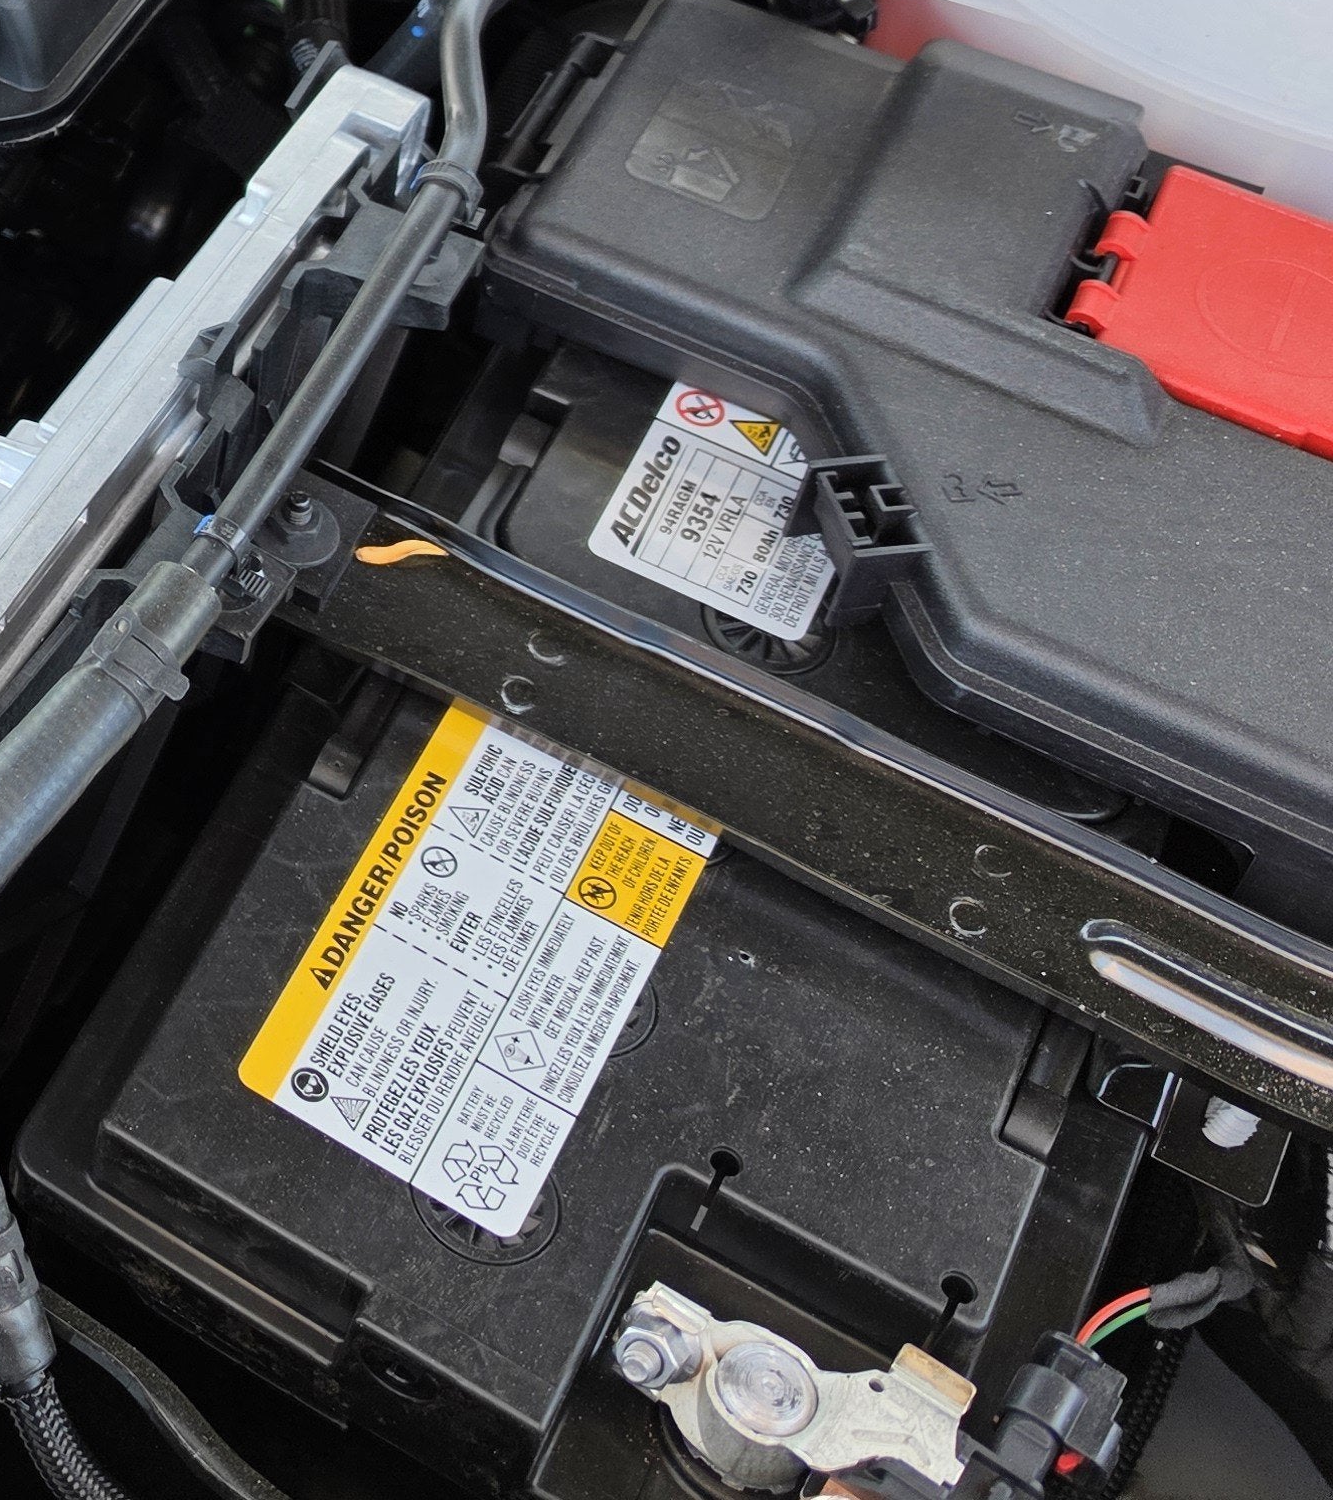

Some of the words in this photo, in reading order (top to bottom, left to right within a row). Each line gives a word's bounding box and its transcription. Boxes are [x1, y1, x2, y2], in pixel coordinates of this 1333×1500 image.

[610, 436, 681, 546] ACDelco
[658, 478, 697, 536] 94RAGM
[773, 494, 794, 522] 730
[678, 489, 721, 545] 9354
[701, 534, 726, 562] 12V
[714, 491, 748, 535] VRLA
[752, 527, 779, 564] 80Ah
[735, 568, 758, 597] 730
[753, 570, 784, 616] GENERAL
[768, 601, 787, 622] 300
[778, 538, 817, 605] RENAISSANCE
[782, 583, 814, 630] DETROIT,
[802, 571, 818, 587] MI
[462, 742, 504, 796] SULFURIC
[479, 775, 506, 805] ACID
[495, 755, 517, 779] CAN
[524, 764, 555, 802] BURNS.
[570, 770, 597, 796] CÉC
[478, 812, 507, 847] CAUSE
[496, 758, 537, 814] BLINDNESS
[503, 800, 535, 840] SEVERE
[512, 824, 545, 866] L'ACIDE
[531, 763, 579, 828] SULFURIQUE
[564, 791, 607, 847] BRÛLURES
[567, 792, 585, 809] LA
[495, 836, 515, 856] OR
[545, 807, 578, 849] CAUSER
[598, 832, 617, 851] OUT
[607, 821, 623, 835] OF
[318, 770, 448, 968] DANGER/POISON
[531, 846, 557, 875] PEUT
[556, 844, 579, 868] DES
[588, 848, 608, 871] KEEP
[605, 860, 624, 880] THE
[613, 835, 637, 865] REACH
[627, 834, 659, 878] CHILDREN.
[654, 855, 671, 870] LA
[548, 865, 568, 884] OU
[621, 875, 638, 889] OF
[636, 879, 659, 906] HORS
[648, 867, 665, 882] DE
[388, 900, 409, 919] NO
[407, 881, 438, 921] SPARKS
[420, 888, 452, 928] FLAMES
[434, 890, 470, 936] SMOKING
[479, 875, 524, 936] ÉTINCELLES
[624, 902, 648, 929] TENIR
[637, 902, 667, 938] PORTÉE
[656, 891, 673, 907] DE
[444, 907, 483, 953] ÉVITER
[471, 933, 493, 956] LES
[486, 941, 508, 964] LES
[497, 894, 534, 944] FLAMMES
[509, 919, 539, 957] FUMER
[584, 933, 607, 961] FAST.
[501, 953, 520, 972] DE
[508, 988, 535, 1021] FLUSH
[524, 967, 546, 992] EYES
[535, 911, 576, 970] IMMEDIATELY
[572, 957, 595, 983] HELP
[584, 931, 632, 999] IMMÉDIATEMENT.
[403, 974, 438, 1020] INJURY.
[525, 1002, 549, 1030] WITH
[538, 970, 566, 1006] WATER.
[552, 980, 583, 1022] MEDICAL
[604, 956, 642, 1011] RAPIDEMENT.
[325, 1010, 374, 1078] EXPLOSIVE
[362, 971, 396, 1013] GASES
[395, 1017, 414, 1037] OR
[457, 997, 497, 1053] AVEUGLE.
[576, 994, 600, 1021] L'EAU
[583, 1005, 616, 1046] MÉDECIN
[309, 1023, 344, 1068] SHIELD
[333, 988, 364, 1026] EYES.
[543, 1019, 563, 1040] GET
[562, 1024, 584, 1049] YEUX
[344, 1061, 368, 1088] CAN
[357, 1025, 388, 1064] CAUSE
[361, 1035, 405, 1098] BLINDNESS
[554, 1045, 574, 1065] LES
[579, 1041, 598, 1058] UN
[356, 1076, 407, 1144] PROTÉGEZ
[395, 1056, 420, 1082] LES
[409, 1018, 440, 1058] YEUX.
[379, 1127, 404, 1155] LES
[392, 1101, 419, 1131] GAZ
[406, 1037, 454, 1105] EXPLOSIFS
[443, 989, 481, 1041] PEUVENT
[434, 1049, 469, 1097] RENDRE
[539, 1062, 565, 1094] RINCEZ
[556, 1054, 591, 1104] CONSULTEZ
[425, 1095, 445, 1115] OU
[456, 1085, 485, 1125] BATTERY
[470, 1106, 490, 1132] MUST
[483, 1093, 497, 1108] BE
[483, 1094, 514, 1140] RECYCLED
[508, 1096, 538, 1139] BATTERIE
[524, 1111, 546, 1138] ÊTRE
[397, 1112, 435, 1165] BLESSER
[501, 1136, 517, 1151] LA
[515, 1135, 535, 1159] DOIT
[526, 1119, 560, 1167] RECYCLÉE
[469, 1160, 490, 1183] Pb
